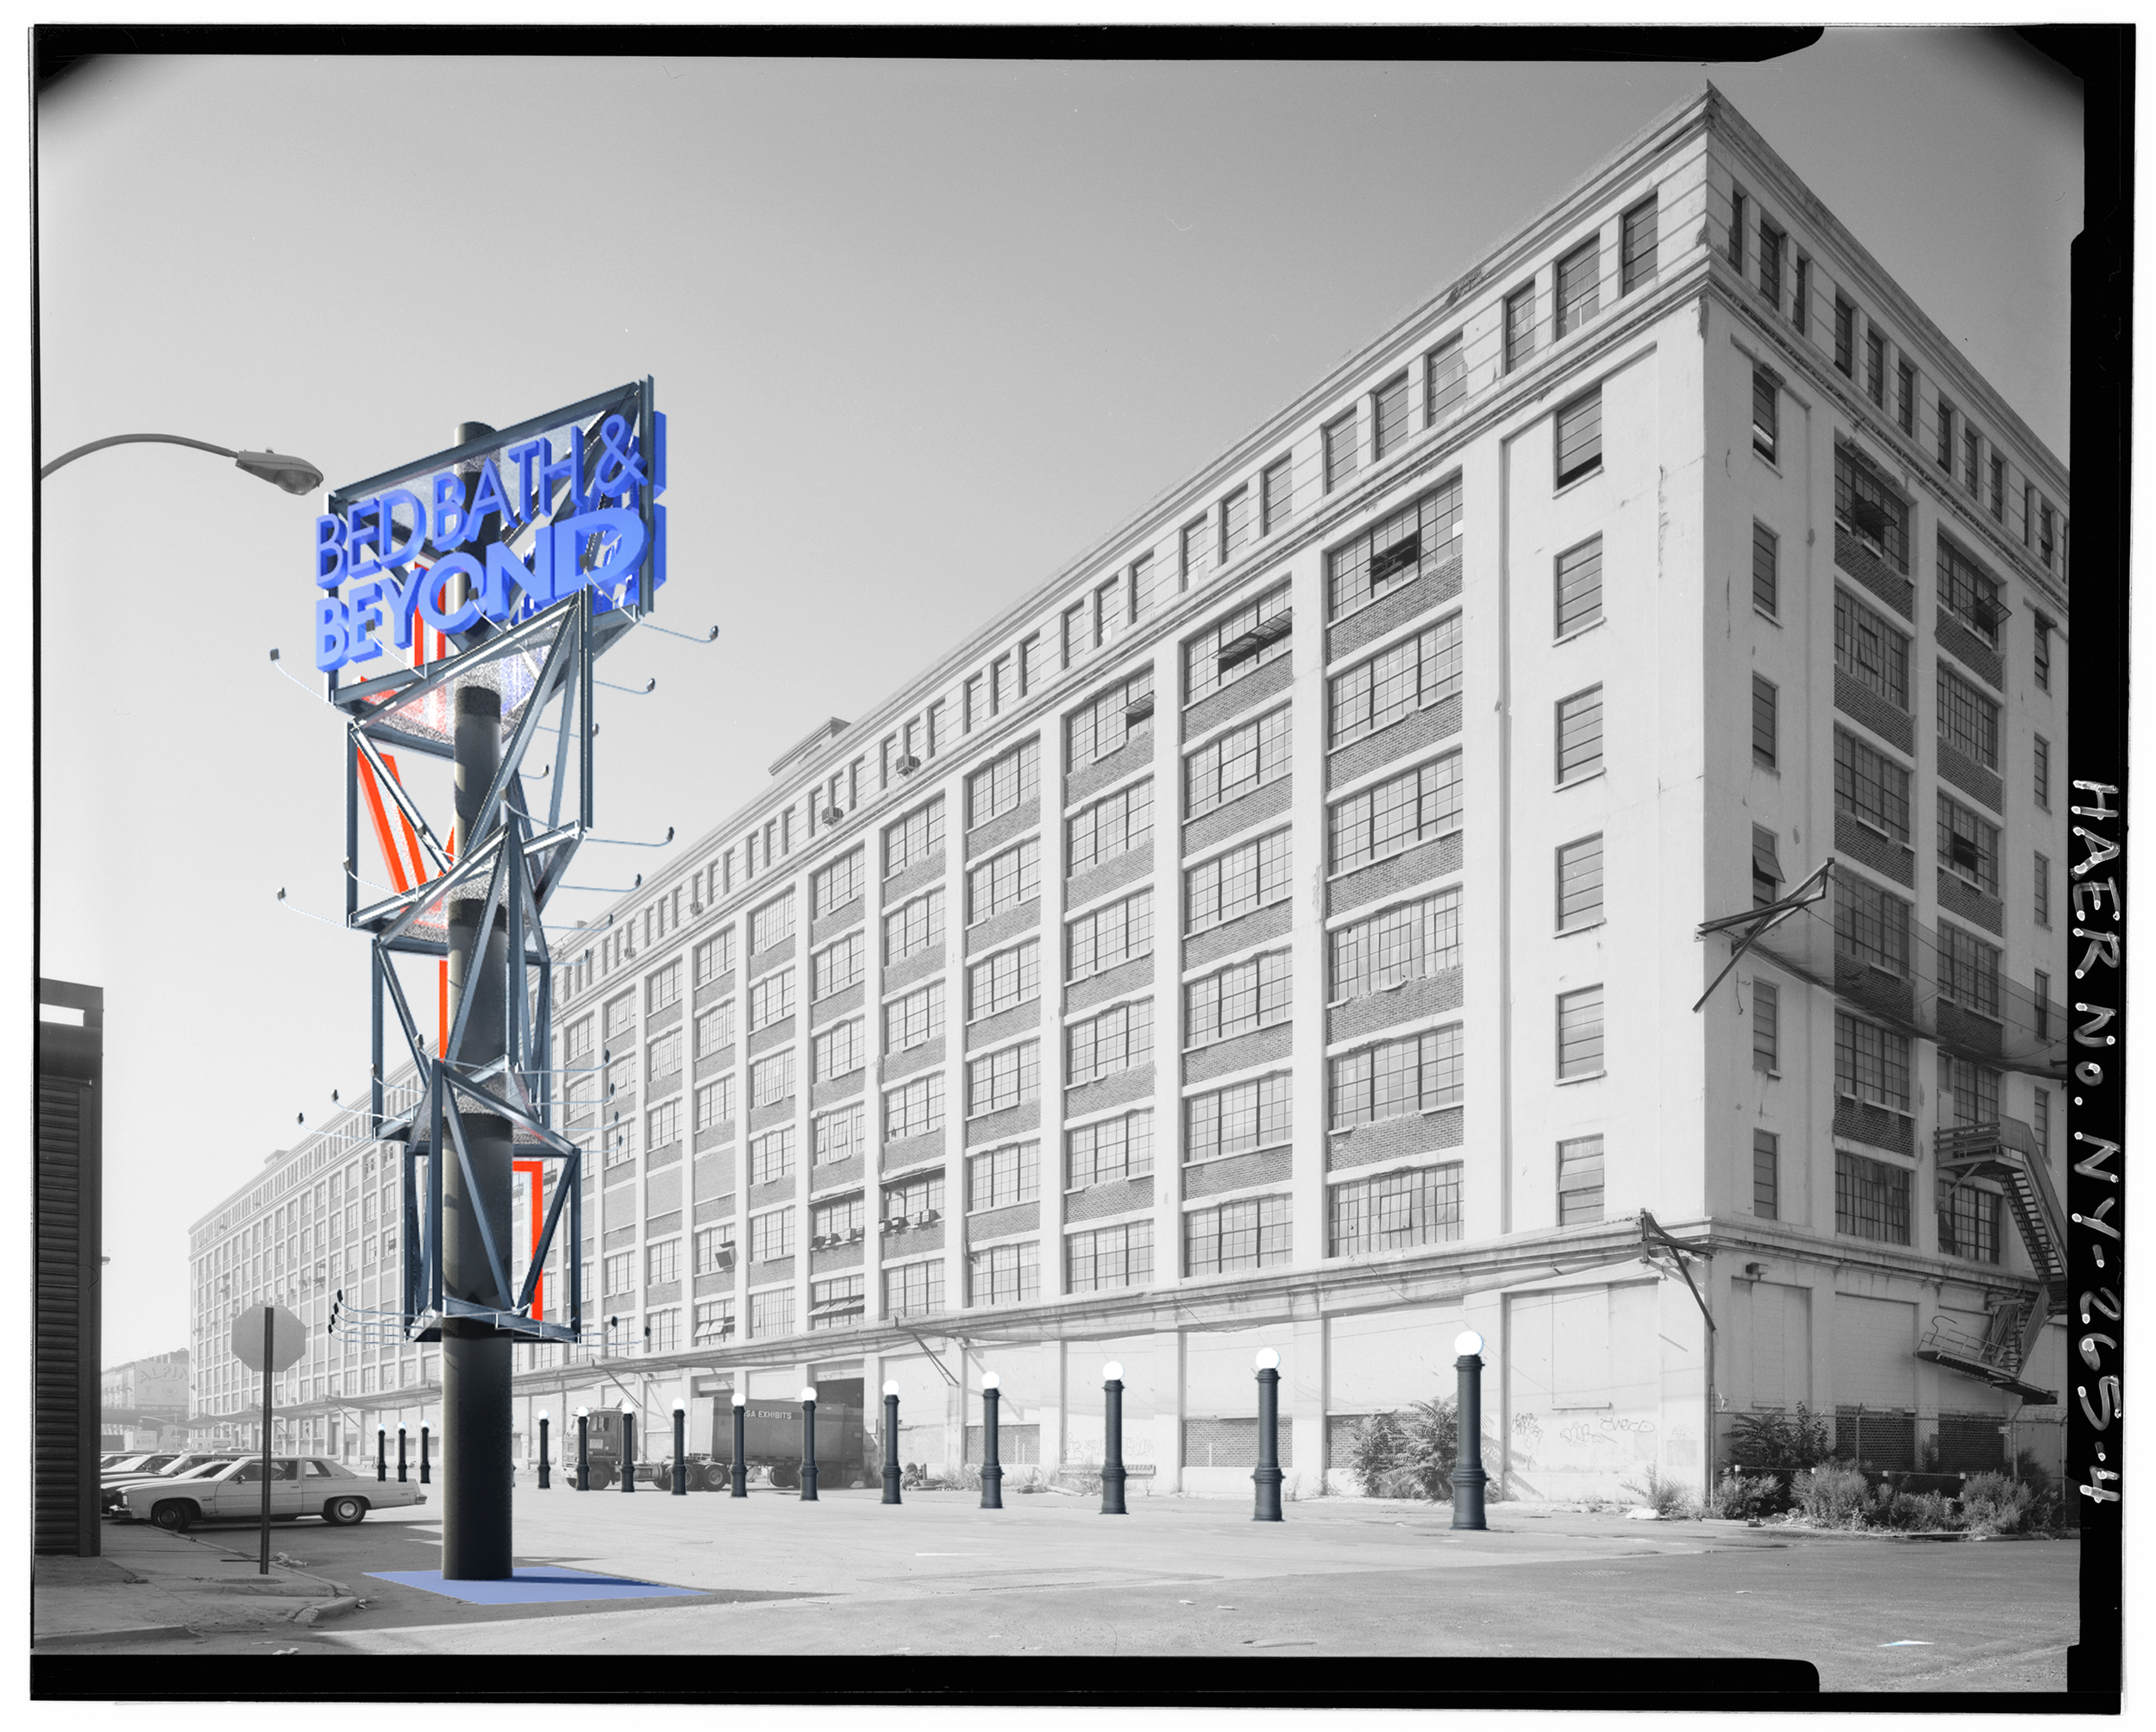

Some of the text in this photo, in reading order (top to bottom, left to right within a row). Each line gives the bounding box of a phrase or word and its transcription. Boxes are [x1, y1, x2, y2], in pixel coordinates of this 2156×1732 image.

[315, 414, 649, 590] BED BATH &
[315, 507, 650, 673] BEYOND
[2070, 779, 2121, 979] HAER
[2071, 1131, 2121, 1503] NY-265-4
[744, 1409, 793, 1420] SA EXHIBITS
